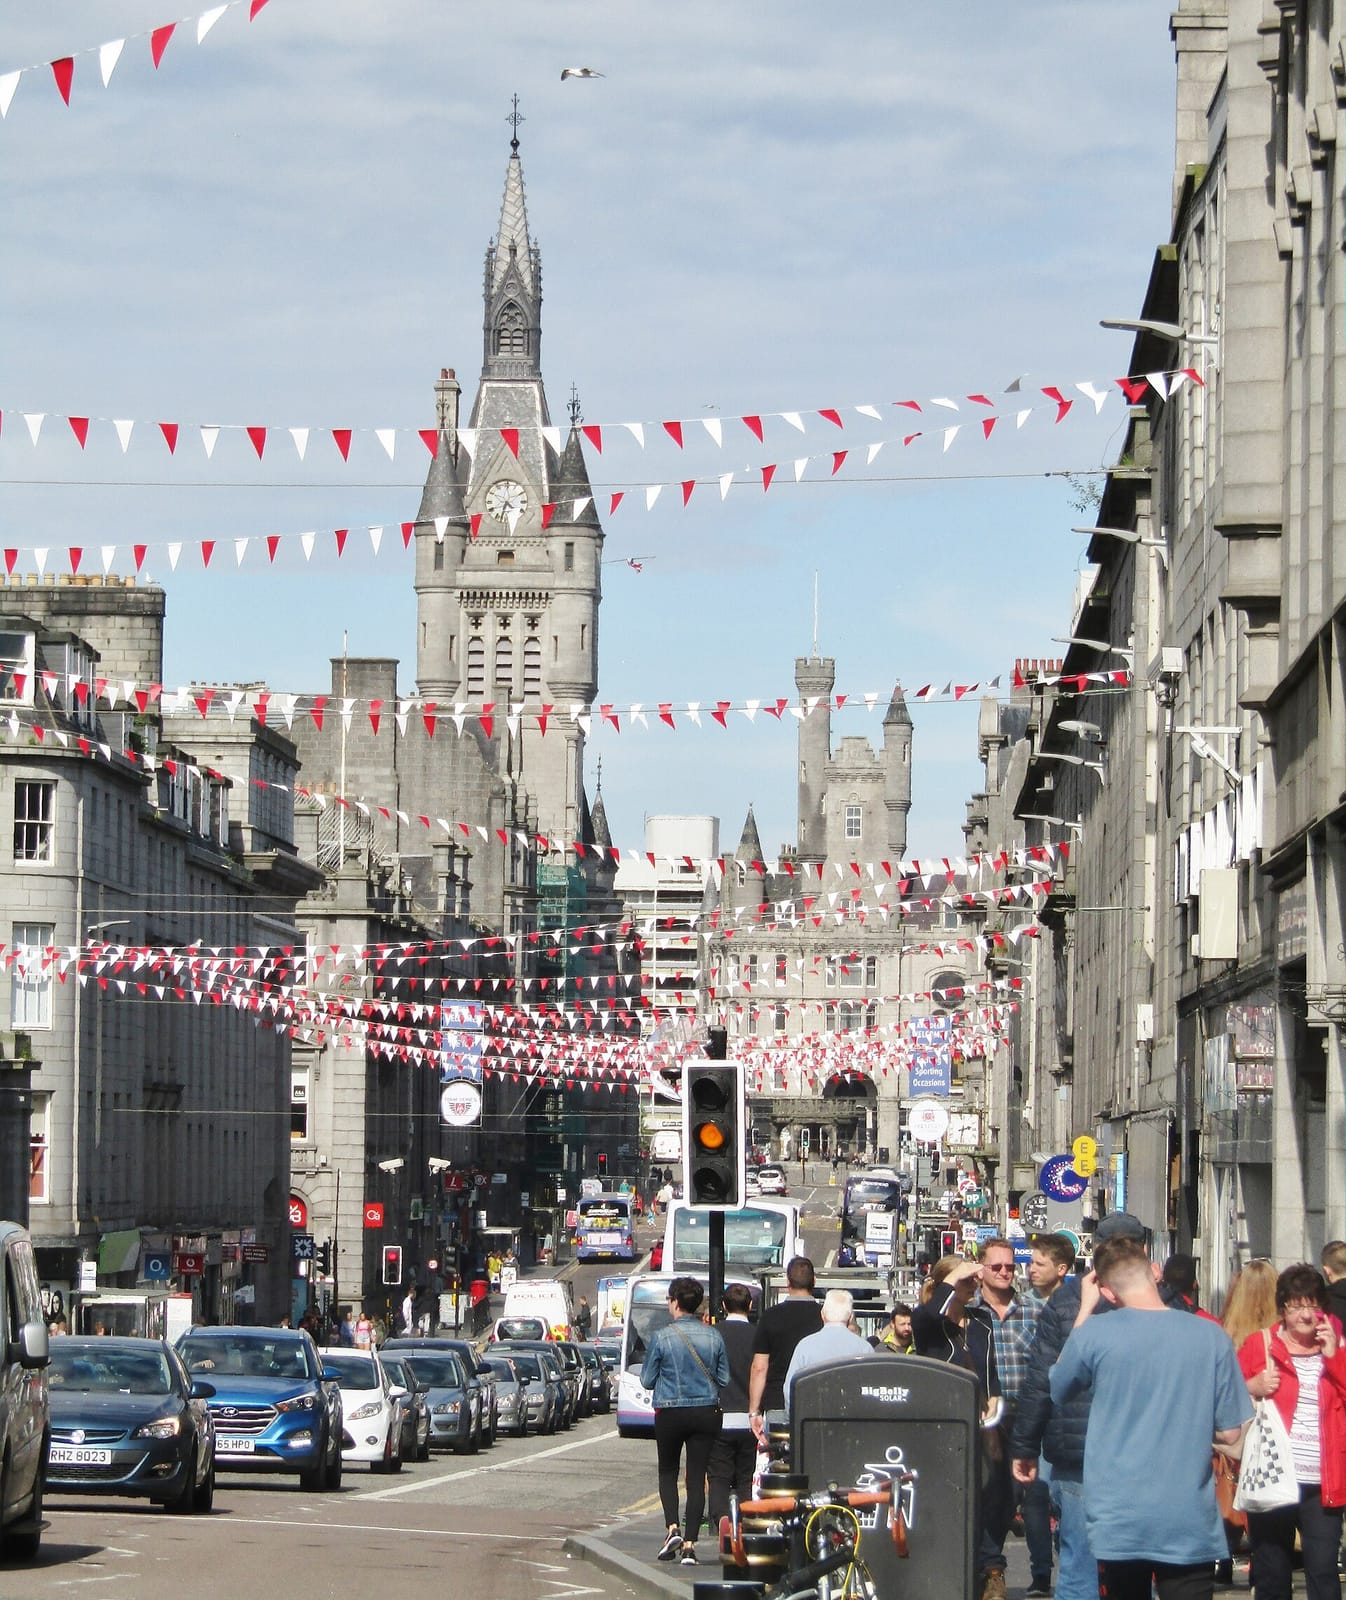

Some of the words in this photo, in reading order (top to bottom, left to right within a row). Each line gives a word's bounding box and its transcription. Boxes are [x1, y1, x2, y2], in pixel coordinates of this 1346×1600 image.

[915, 1068, 943, 1077] Sporting
[912, 1079, 946, 1087] Occasions
[513, 1292, 557, 1300] POLICE
[50, 1450, 73, 1462] RHZ
[76, 1451, 106, 1463] 8023
